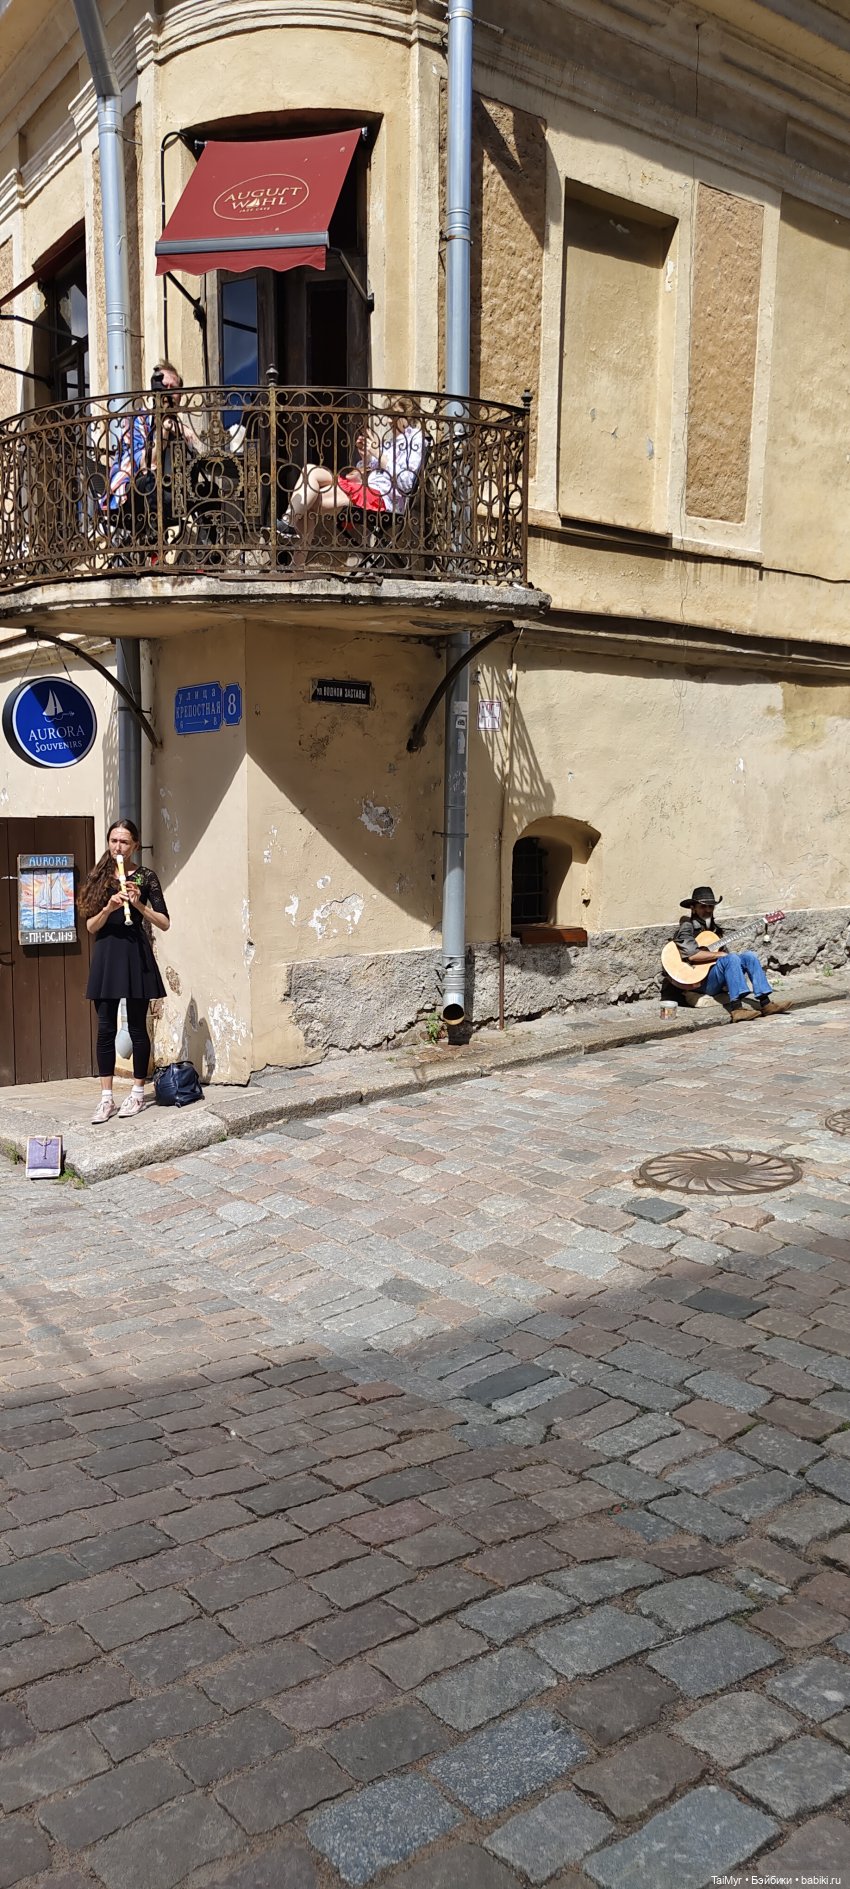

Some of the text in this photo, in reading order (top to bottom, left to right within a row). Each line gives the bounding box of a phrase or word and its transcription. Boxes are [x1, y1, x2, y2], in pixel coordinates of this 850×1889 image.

[224, 187, 302, 202] AUGUST
[178, 687, 216, 704] улица
[344, 688, 366, 699] ЗАСТАВЫ
[175, 701, 221, 719] КРЕПОСТНАЯ
[227, 693, 237, 716] 8
[28, 724, 85, 742] AURORA
[29, 856, 68, 867] AURORA
